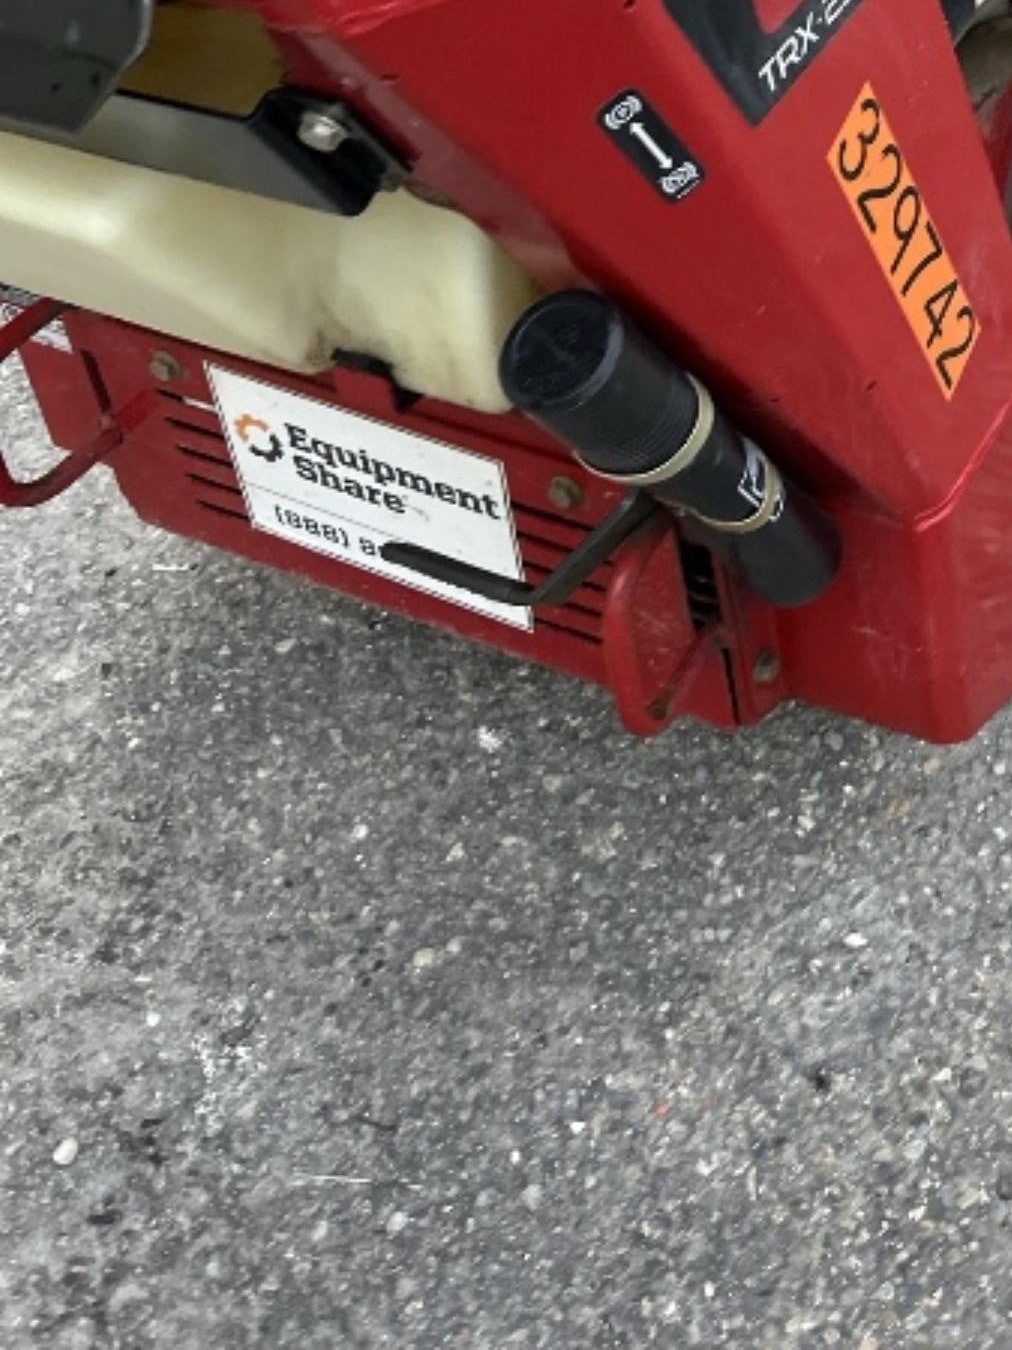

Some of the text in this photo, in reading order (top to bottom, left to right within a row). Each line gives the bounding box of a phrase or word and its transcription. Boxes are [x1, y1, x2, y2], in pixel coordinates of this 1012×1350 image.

[838, 98, 976, 391] 329742
[284, 422, 502, 520] Equipment
[292, 454, 406, 515] Share
[274, 503, 351, 549] (888)
